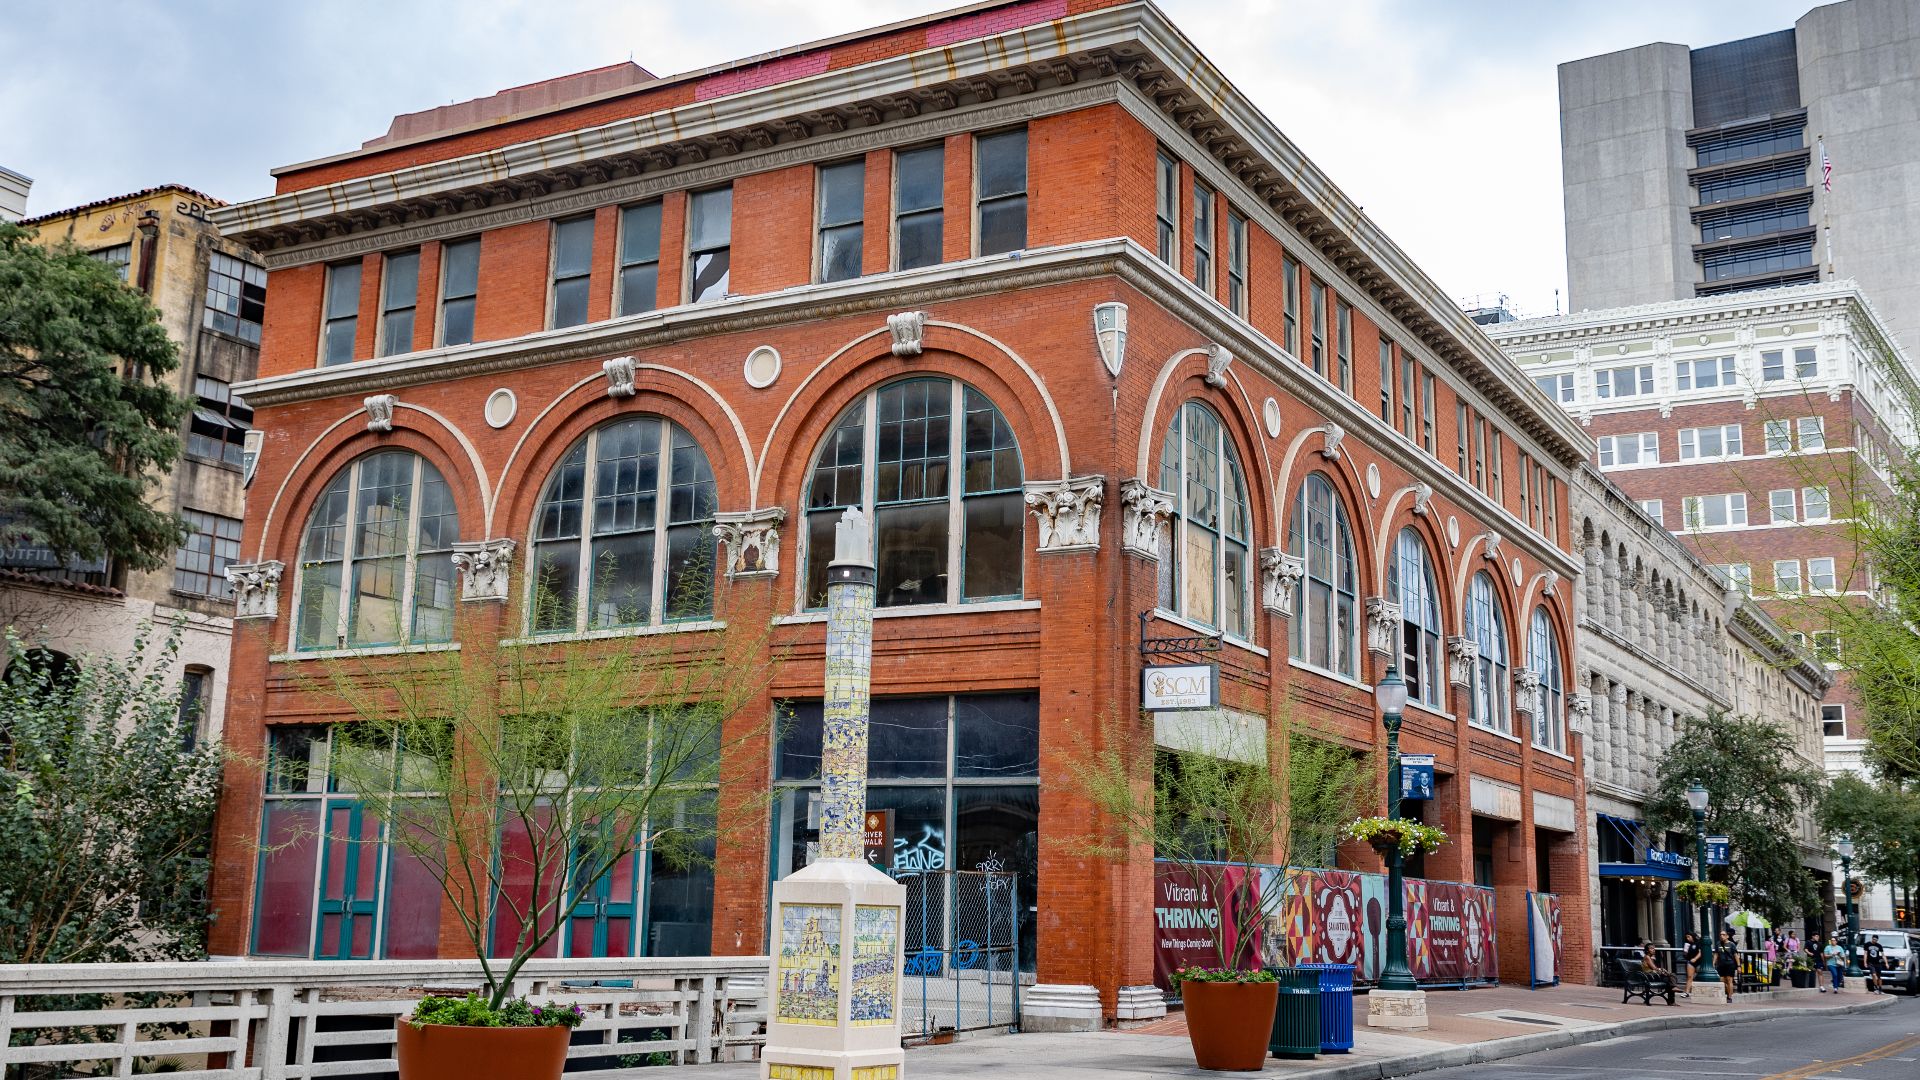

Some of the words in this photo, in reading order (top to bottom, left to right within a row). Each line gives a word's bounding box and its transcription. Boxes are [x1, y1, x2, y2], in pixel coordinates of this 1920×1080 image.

[1165, 676, 1207, 695] SCM
[1201, 883, 1208, 902] &
[1432, 897, 1450, 912] Vibrant
[1154, 907, 1219, 929] THRIVING
[1429, 915, 1461, 932] THRIVING
[1161, 938, 1172, 948] New
[1172, 938, 1187, 951] Things
[1186, 938, 1201, 950] Coming
[1201, 938, 1214, 948] Soon!
